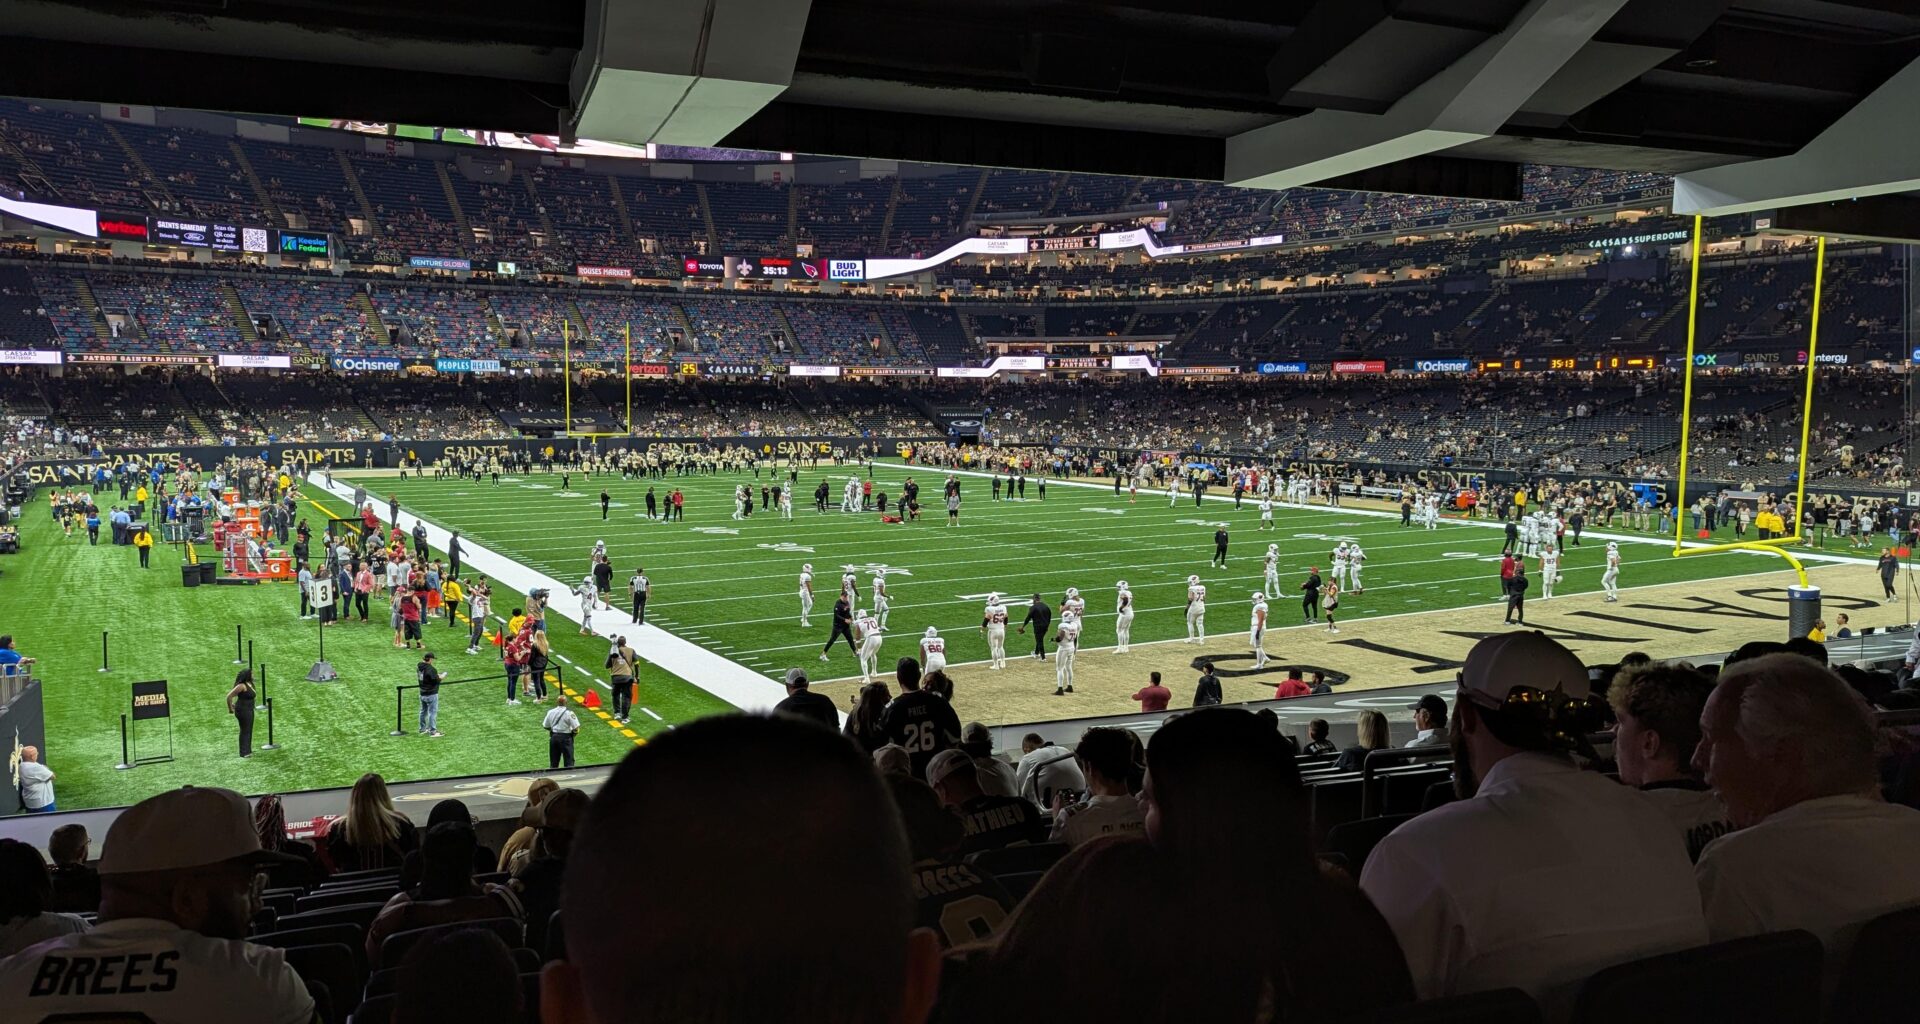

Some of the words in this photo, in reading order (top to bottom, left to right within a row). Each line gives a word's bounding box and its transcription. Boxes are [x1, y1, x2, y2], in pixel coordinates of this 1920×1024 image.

[1572, 197, 1603, 208] SAINTS
[1507, 206, 1536, 216] SAINTS
[1447, 214, 1475, 224] SAINTS
[99, 221, 147, 236] verizon
[157, 220, 179, 230] SAINTS
[180, 223, 207, 232] GAMEDAY
[298, 237, 327, 246] Keesler
[1588, 236, 1633, 248] CAESARS
[1634, 230, 1688, 244] SUPERDOME
[298, 244, 327, 253] Federal
[411, 259, 443, 267] VENTURE
[443, 260, 470, 268] GLOBAL
[836, 262, 856, 270] BUD
[542, 264, 569, 273] SAINTS
[578, 266, 601, 276] ROUSES
[602, 267, 631, 277] MARKETS
[763, 266, 788, 275] 35:13
[832, 269, 861, 277] LIGHT
[292, 357, 326, 365] SAINTS
[1692, 353, 1717, 365] OX
[1743, 353, 1779, 362] SAINTS
[1813, 353, 1848, 363] ntergy
[343, 358, 400, 371] Ochsner
[438, 361, 470, 370] PEOPLES
[472, 361, 499, 370] HEALTH
[510, 360, 540, 368] SAINTS
[574, 361, 602, 369] SAINTS
[1335, 362, 1366, 372] Community
[1423, 360, 1468, 372] Ochsner
[1514, 360, 1520, 369] 0
[1551, 359, 1574, 368] 35:13
[1611, 358, 1617, 367] 0
[1647, 359, 1653, 368] 3
[625, 363, 668, 374] verizon
[682, 363, 695, 374] 25
[708, 365, 754, 374] CAESARS
[761, 364, 786, 372] SAINTS
[1274, 364, 1300, 372] Allstate
[1910, 494, 1917, 504] 2
[270, 563, 280, 573] G
[320, 584, 328, 602] 3
[864, 620, 878, 631] 70
[135, 694, 166, 702] MEDIA
[907, 704, 928, 717] PRICE
[903, 720, 935, 752] 26
[285, 821, 314, 830] BRIDE
[28, 950, 181, 997] BREES
